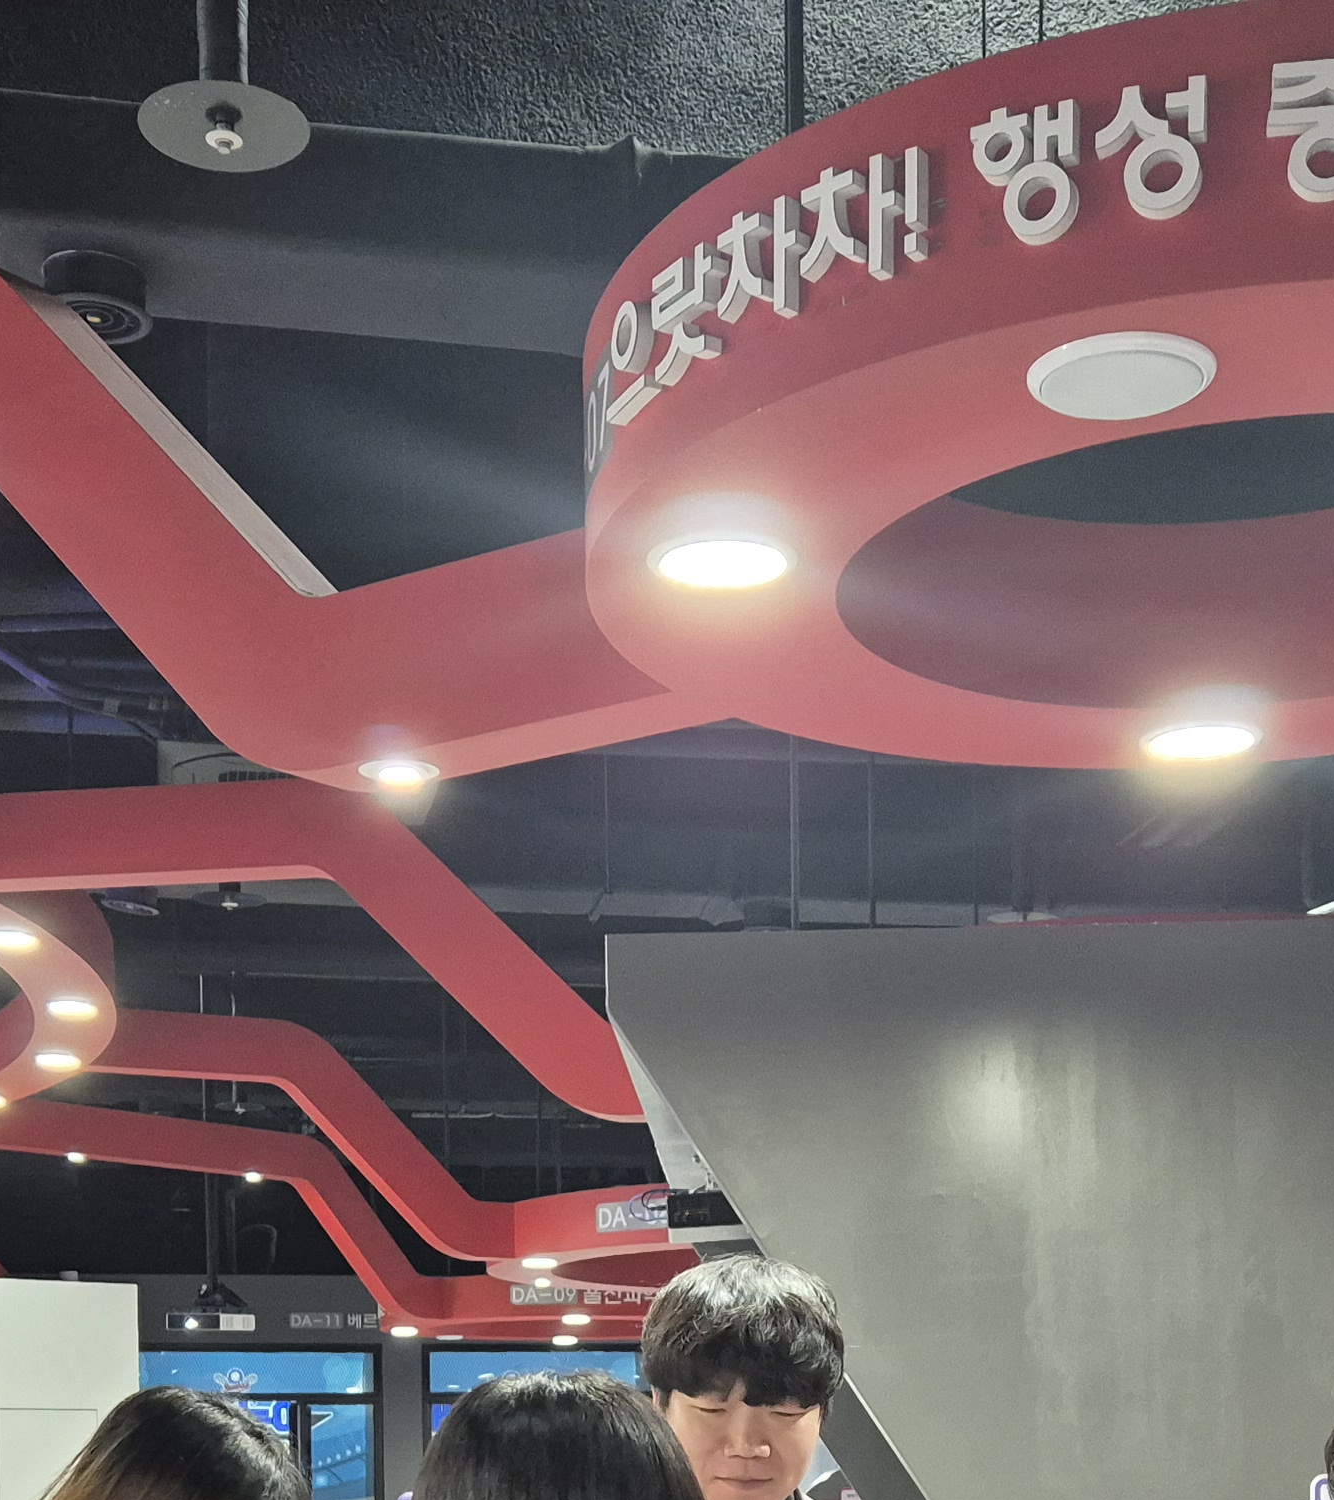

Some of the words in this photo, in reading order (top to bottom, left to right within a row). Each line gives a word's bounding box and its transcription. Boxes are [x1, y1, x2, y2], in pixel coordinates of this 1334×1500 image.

[606, 145, 929, 426] 으랏차차!
[970, 75, 1208, 246] 행성
[512, 1288, 577, 1303] DA-09
[291, 1313, 341, 1328] DA-11
